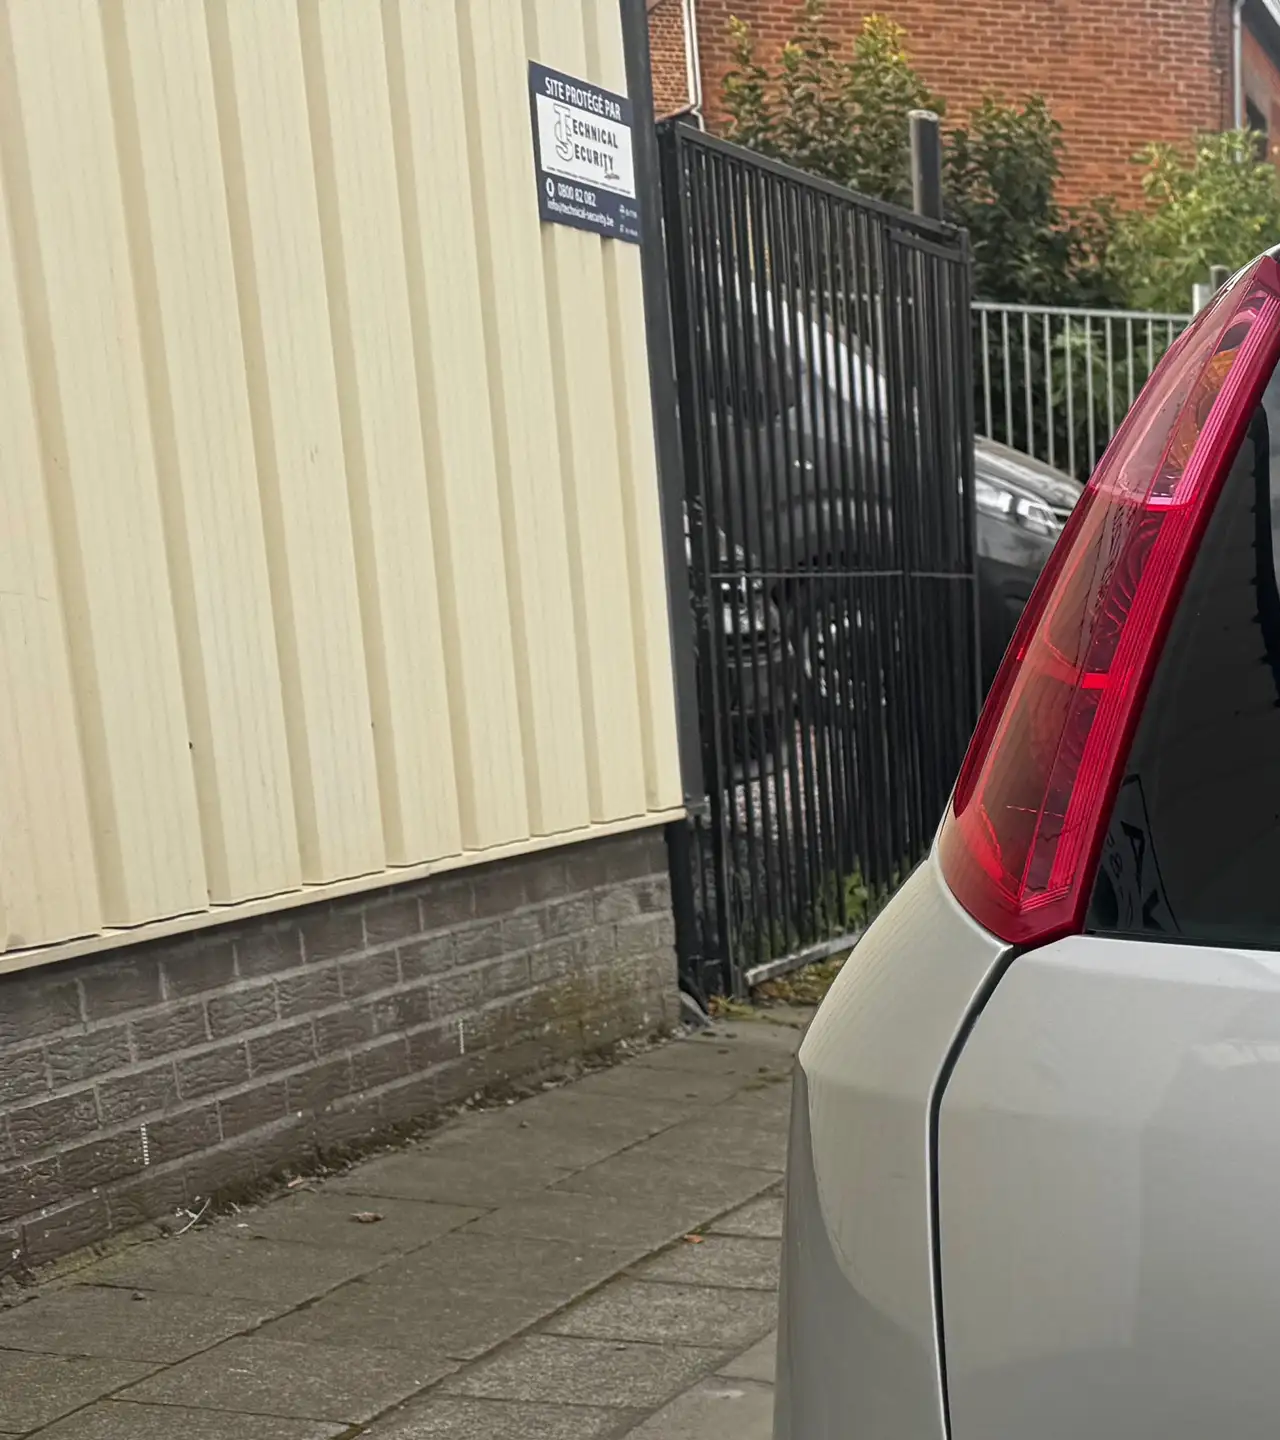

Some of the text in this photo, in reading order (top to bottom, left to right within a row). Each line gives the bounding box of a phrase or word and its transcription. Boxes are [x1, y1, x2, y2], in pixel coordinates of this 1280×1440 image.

[545, 77, 621, 121] SITE PROTÉGÉ PAR
[553, 103, 619, 149] TECHNICAL
[554, 120, 613, 172] SECURITY
